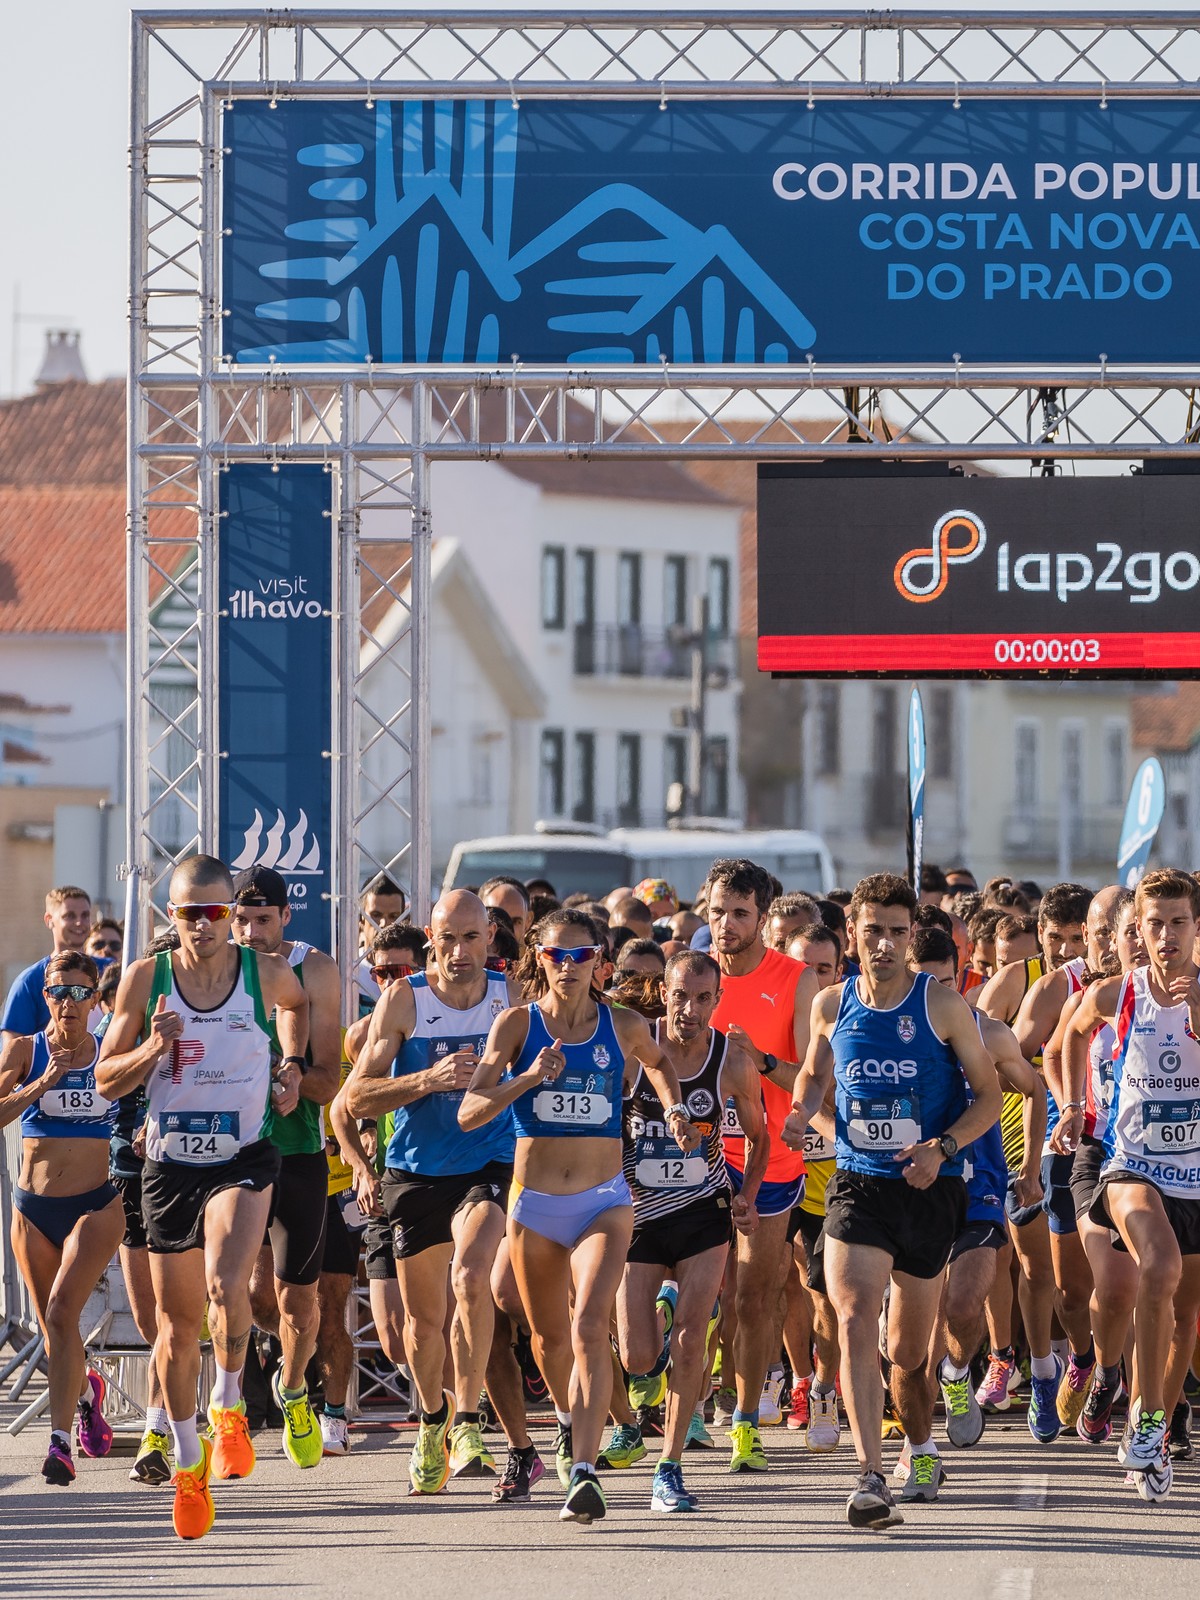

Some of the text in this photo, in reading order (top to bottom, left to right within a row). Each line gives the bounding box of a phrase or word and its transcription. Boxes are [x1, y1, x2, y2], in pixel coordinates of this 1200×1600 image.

[772, 162, 1017, 200] CORRIDA
[858, 212, 1200, 250] COSTA NOVA
[888, 262, 1172, 301] DO PRADO
[997, 542, 1200, 603] lap2go
[259, 576, 308, 597] visit
[994, 639, 1101, 663] 00:00:03
[1138, 764, 1154, 826] 6
[193, 1070, 225, 1079] JPAIVA
[58, 1091, 94, 1108] 183
[552, 1094, 591, 1114] 313
[868, 1122, 892, 1140] 90
[1161, 1122, 1198, 1142] 607
[180, 1135, 217, 1154] 124
[660, 1161, 684, 1178] 12
